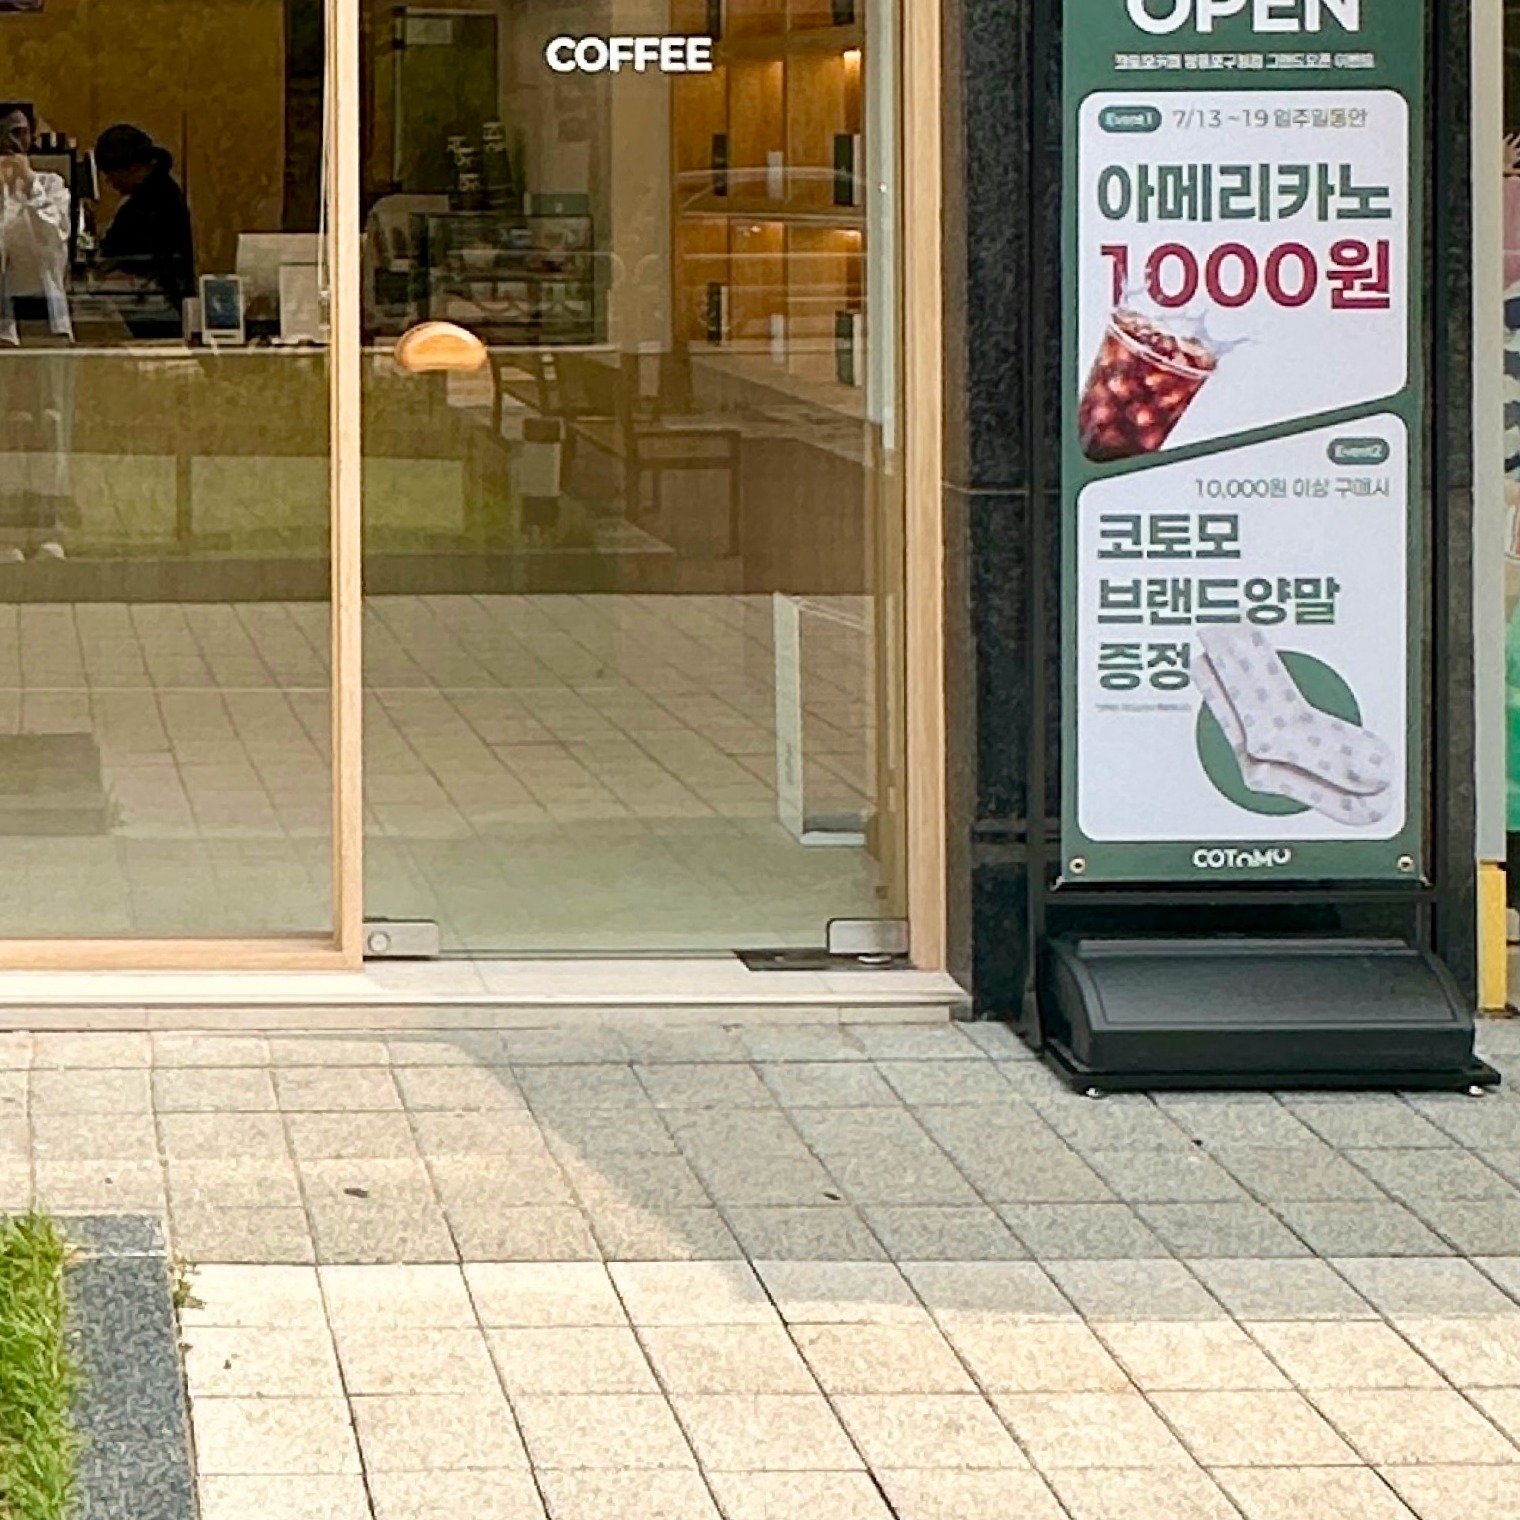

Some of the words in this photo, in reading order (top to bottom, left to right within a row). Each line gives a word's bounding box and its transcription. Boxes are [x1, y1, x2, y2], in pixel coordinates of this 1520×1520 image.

[546, 36, 713, 72] COFFEE
[1097, 163, 1392, 223] 아메리카노
[1100, 238, 1391, 310] 1000원
[1292, 478, 1329, 498] 이상
[1097, 513, 1241, 559] 코토모
[1097, 576, 1341, 626] 브랜드양말
[1097, 642, 1191, 691] 증정
